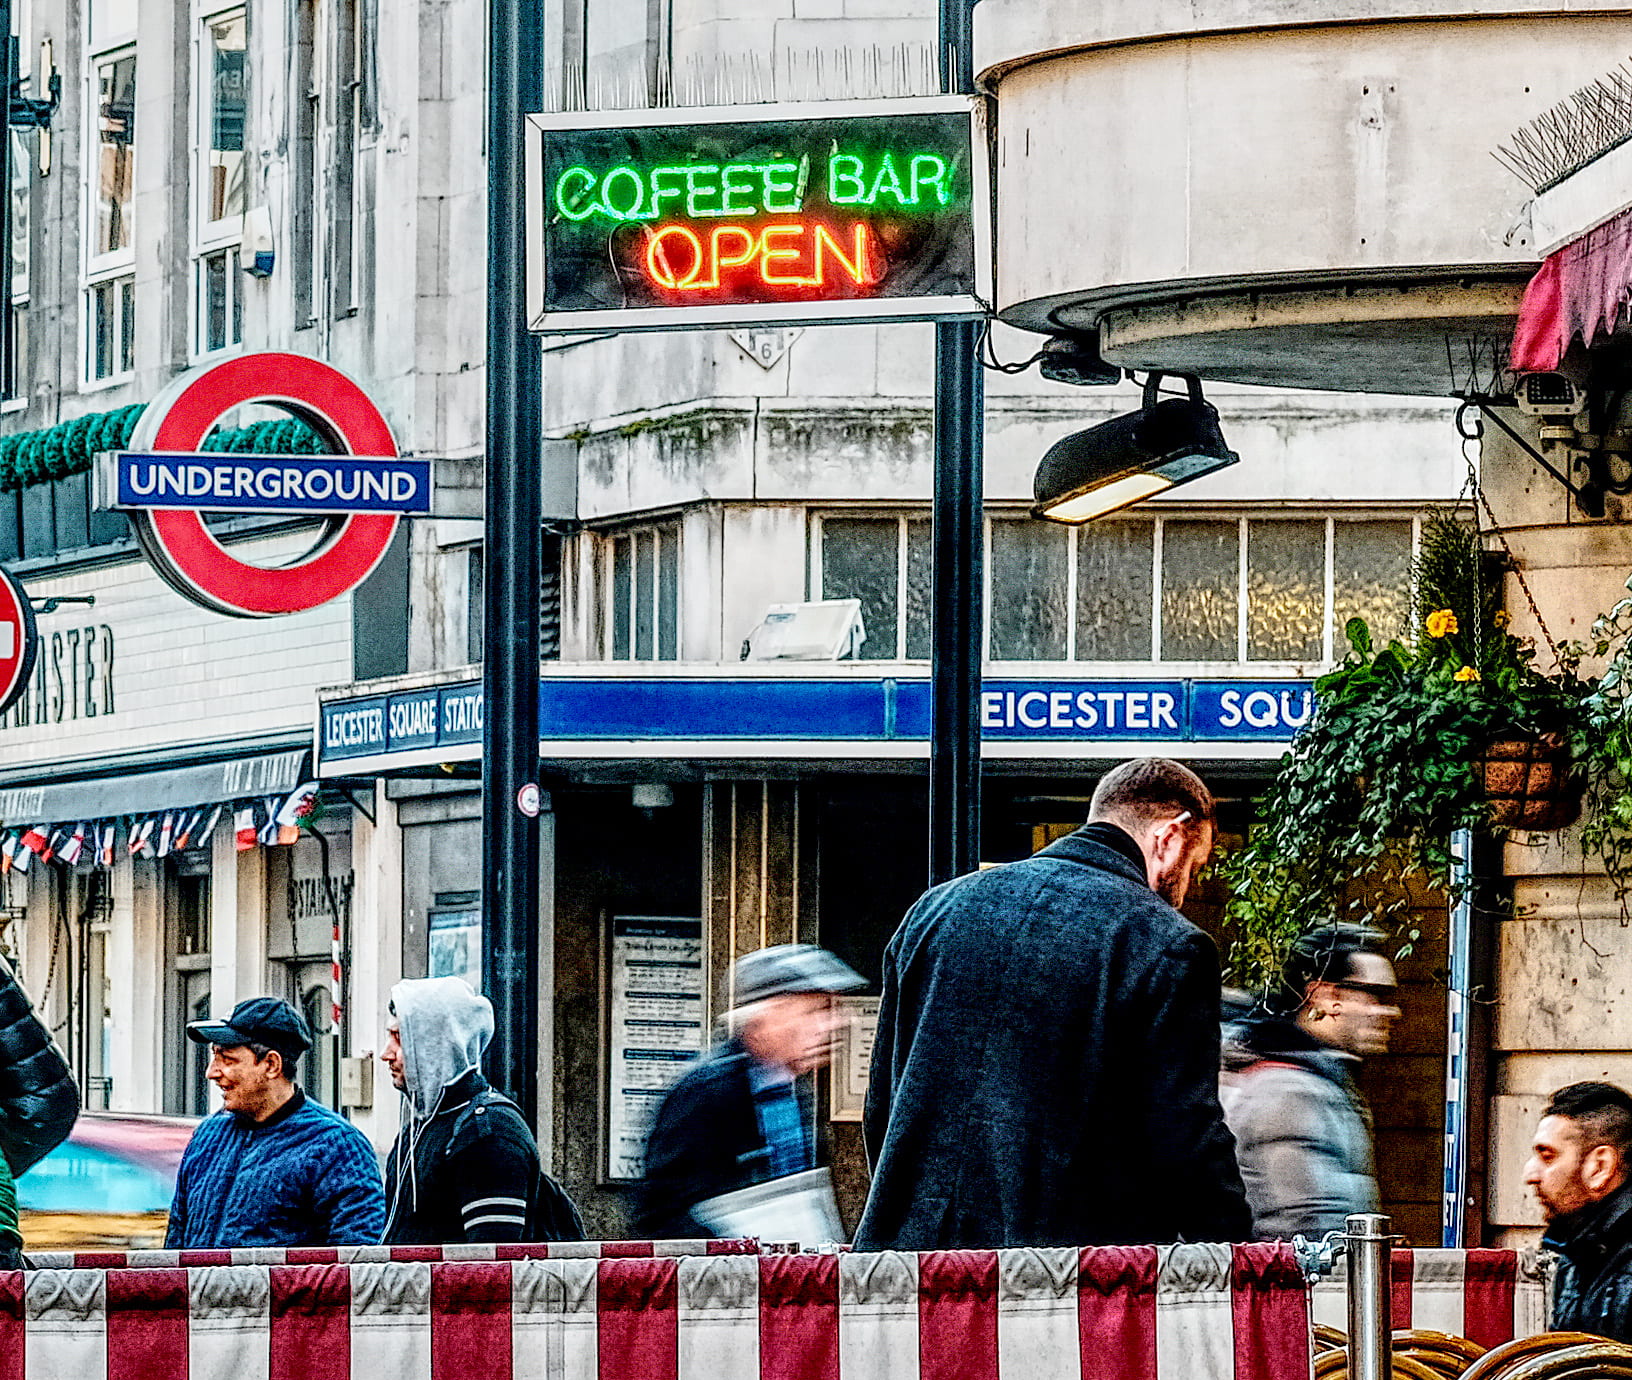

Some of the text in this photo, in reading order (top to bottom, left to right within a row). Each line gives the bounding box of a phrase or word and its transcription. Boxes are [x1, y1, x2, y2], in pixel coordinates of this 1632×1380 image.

[828, 153, 950, 206] BAR
[647, 223, 867, 289] OPEN
[129, 463, 418, 502] UNDERGROUND
[325, 693, 483, 748] LEICESTER SQUARE STATIO
[981, 690, 1314, 729] EICESTER SQU
